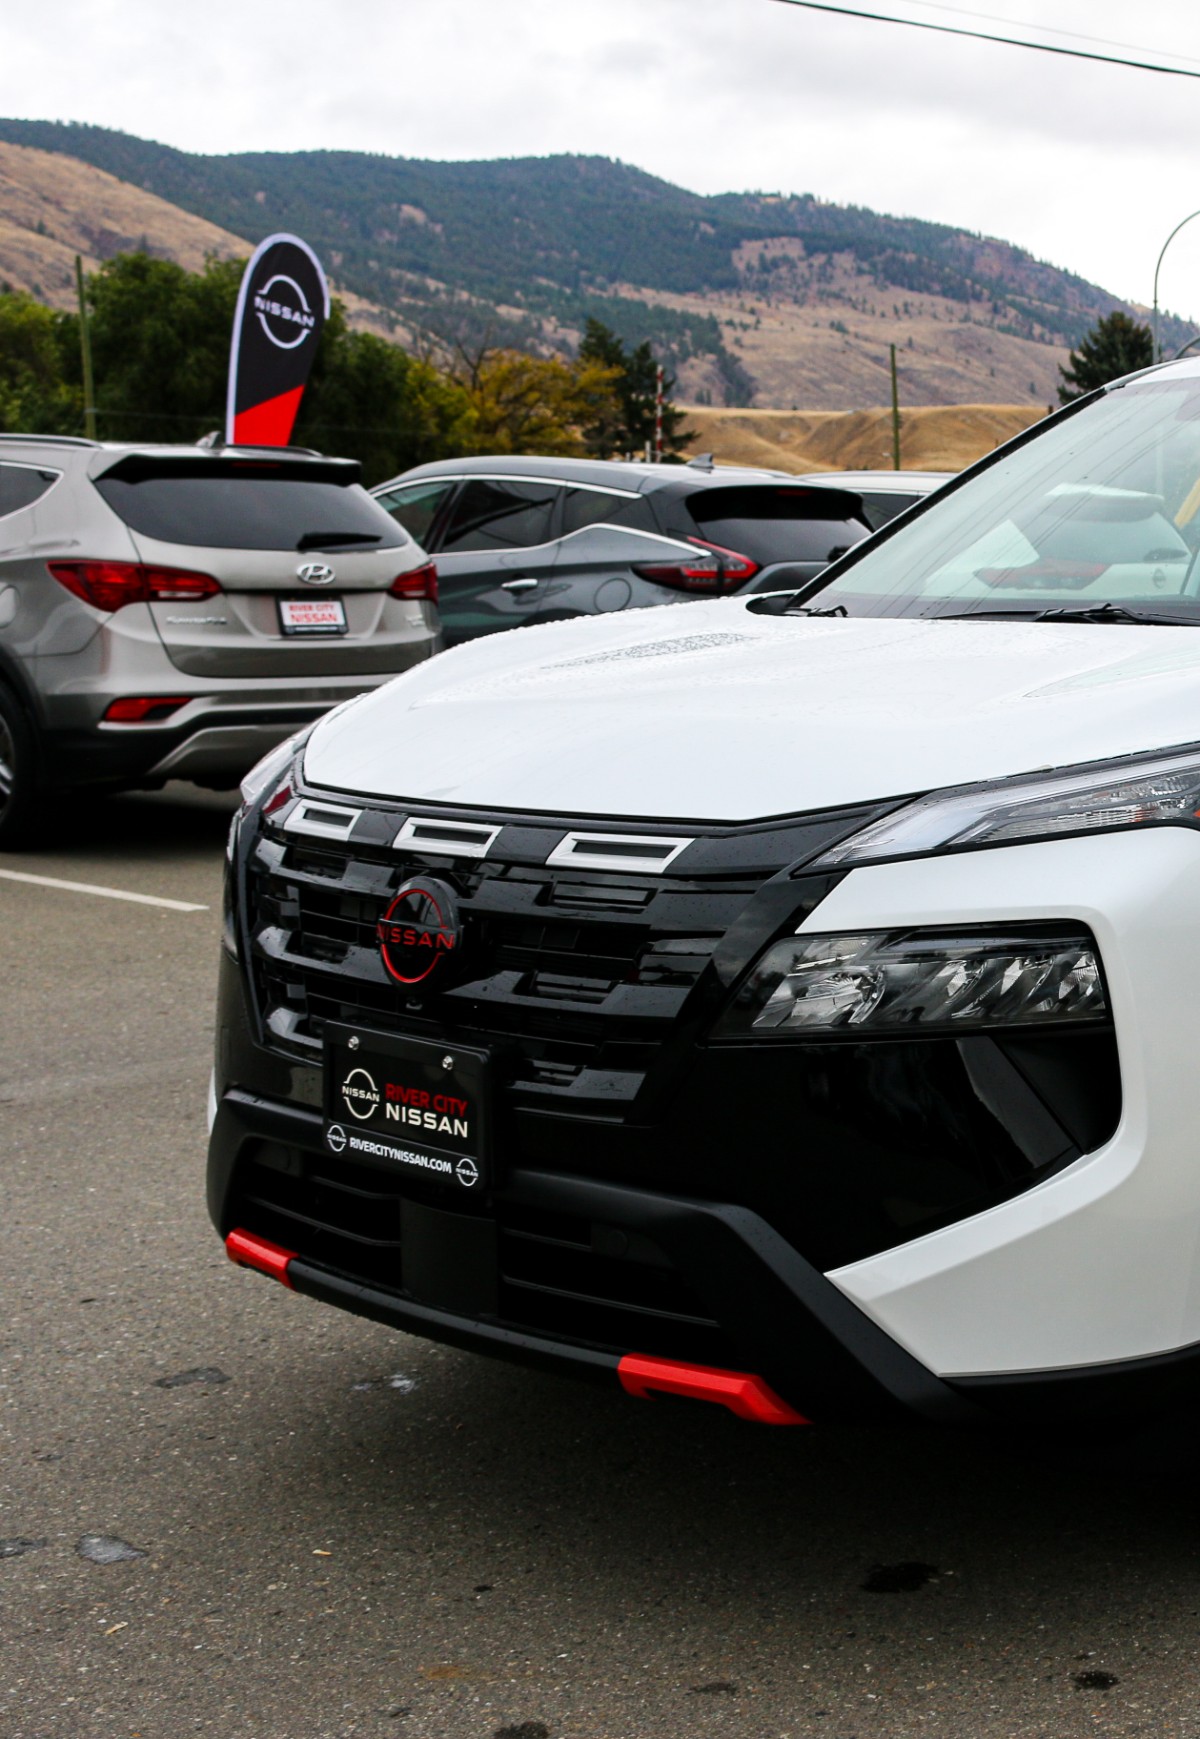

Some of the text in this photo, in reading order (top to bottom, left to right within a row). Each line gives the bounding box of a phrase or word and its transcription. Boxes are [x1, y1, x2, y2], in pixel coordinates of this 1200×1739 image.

[254, 296, 315, 328] NISSAN
[288, 603, 334, 612] RIVER CITY
[290, 613, 338, 623] NISSAN
[376, 924, 455, 950] NISSAN
[342, 1085, 380, 1102] NISSAN
[385, 1083, 468, 1117] RIVER CITY
[386, 1102, 468, 1138] NISSAN
[327, 1133, 347, 1143] NISSAN
[350, 1137, 452, 1173] RIVERCITYNISSAN.COM
[456, 1167, 479, 1177] NISSAN
